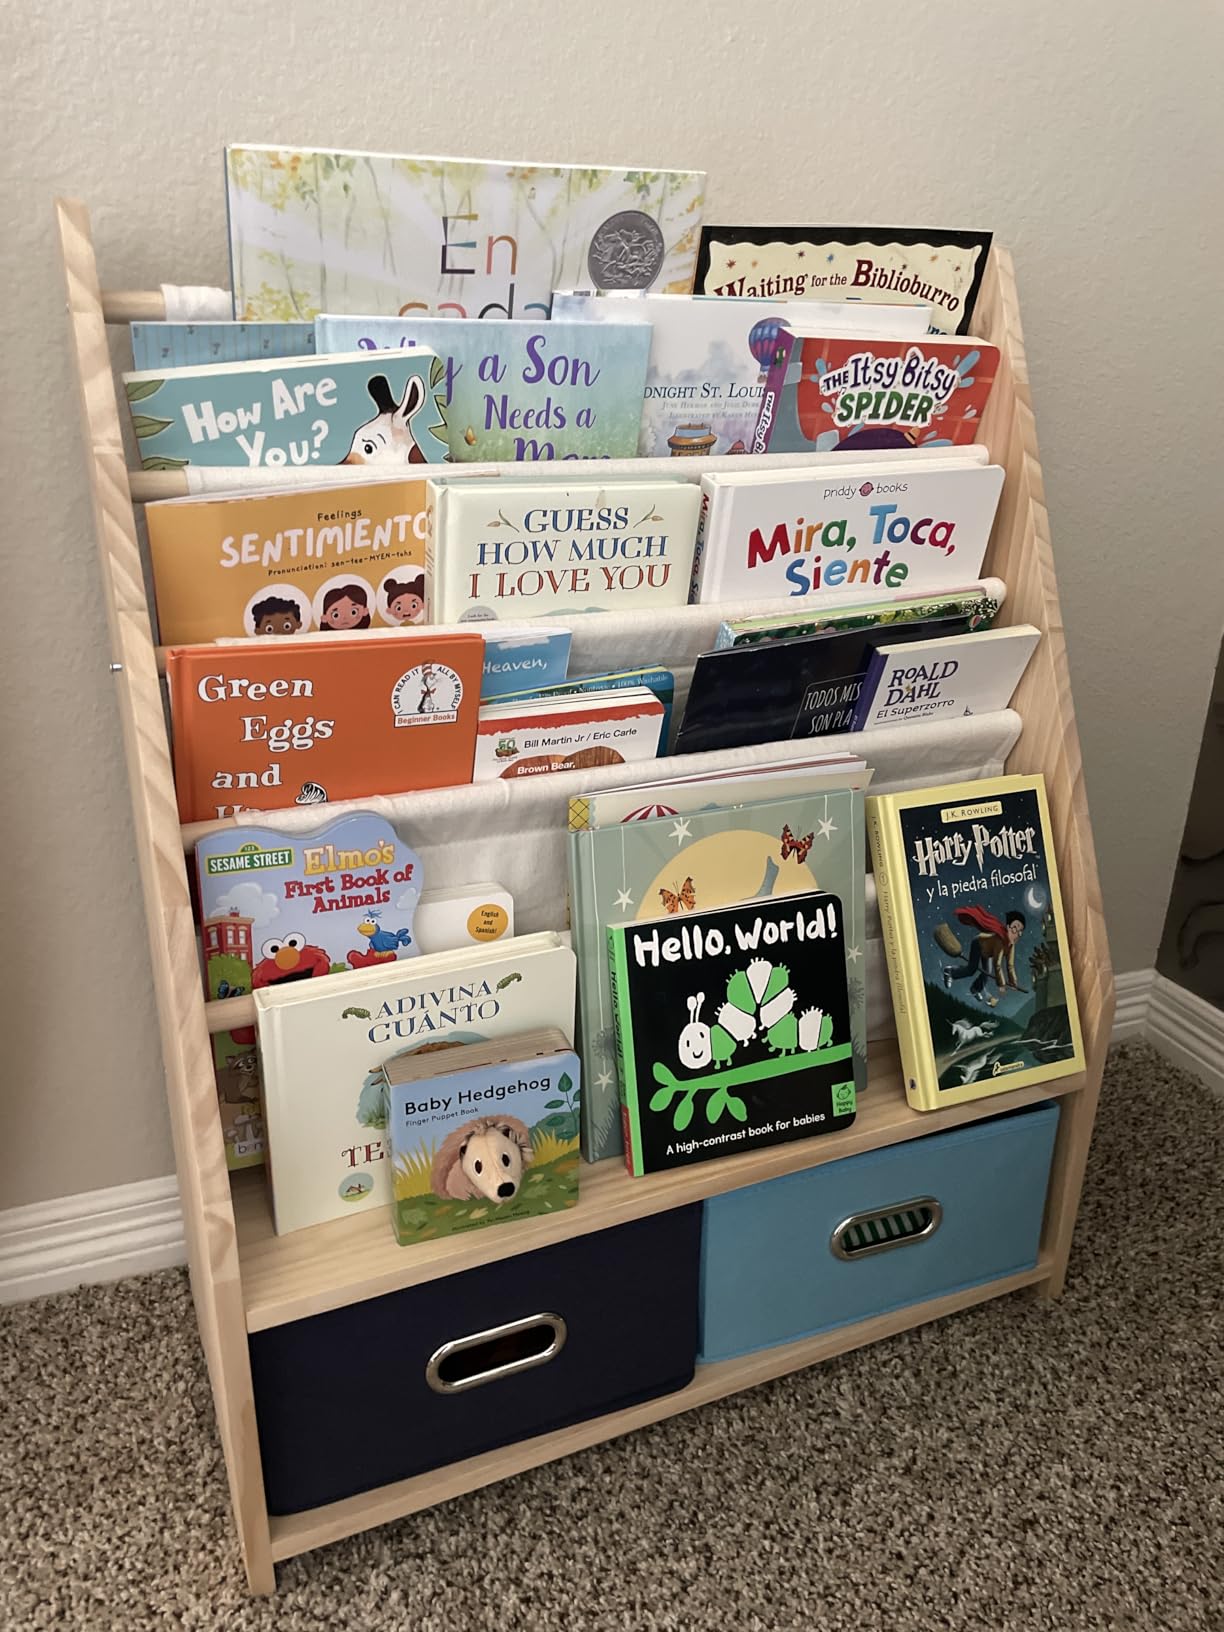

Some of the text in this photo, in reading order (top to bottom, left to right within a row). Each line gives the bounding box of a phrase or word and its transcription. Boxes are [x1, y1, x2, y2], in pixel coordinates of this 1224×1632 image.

[441, 213, 518, 275] En
[811, 275, 828, 287] for
[829, 273, 847, 286] the
[850, 259, 960, 312] Biblioburro
[478, 354, 506, 383] a
[522, 335, 600, 387] Son
[823, 355, 956, 400] THE Itsy Bitsy
[182, 378, 337, 444] How Are
[484, 394, 597, 430] Needs a
[837, 391, 934, 423] SPIDER
[236, 420, 329, 466] You?
[823, 482, 908, 500] priddy books
[317, 509, 362, 522] Feelings
[524, 507, 629, 533] GUESS
[747, 504, 956, 569] Mira, Toca,
[476, 535, 669, 567] HOW MUCH
[468, 563, 672, 599] I LOVE YOU
[785, 550, 909, 596] Siente
[411, 668, 420, 676] IT
[437, 666, 450, 675] ALL
[449, 673, 459, 682] BY
[482, 657, 548, 674] Heaven,
[888, 660, 959, 688] ROALD
[198, 674, 314, 702] Green
[395, 674, 411, 692] READ
[451, 683, 461, 710] MYSELF
[804, 682, 863, 711] TODOS MIS
[884, 682, 942, 707] DAHL
[393, 695, 401, 710] CAN
[876, 710, 888, 719] El
[890, 699, 955, 717] Superzorro
[397, 713, 455, 725] Beginner Books
[808, 715, 833, 735] SON
[240, 715, 335, 753] Eggs
[524, 738, 539, 748] Bill
[541, 734, 574, 747] Martin
[575, 733, 585, 743] Jr
[593, 730, 611, 741] Eric
[613, 728, 637, 738] Carle
[211, 763, 283, 790] and
[517, 764, 549, 774] Brown
[961, 805, 999, 817] ROWLING
[210, 851, 290, 872] SESAME STREET
[303, 839, 395, 876] Elmo's
[912, 824, 1037, 877] Harry Potter
[284, 863, 414, 899] First Book of
[926, 863, 1036, 903] y la piedra filosofal
[312, 887, 390, 914] Animals
[633, 903, 838, 967] Hello, World!
[375, 980, 491, 1020] ADIVINA
[368, 1000, 500, 1043] CUÁNTO
[405, 1078, 550, 1115] Baby Hedgehog
[406, 1107, 479, 1127] Finger Puppet Book
[666, 1113, 826, 1155] A high-contrast book for babies
[341, 1141, 384, 1168] TE
